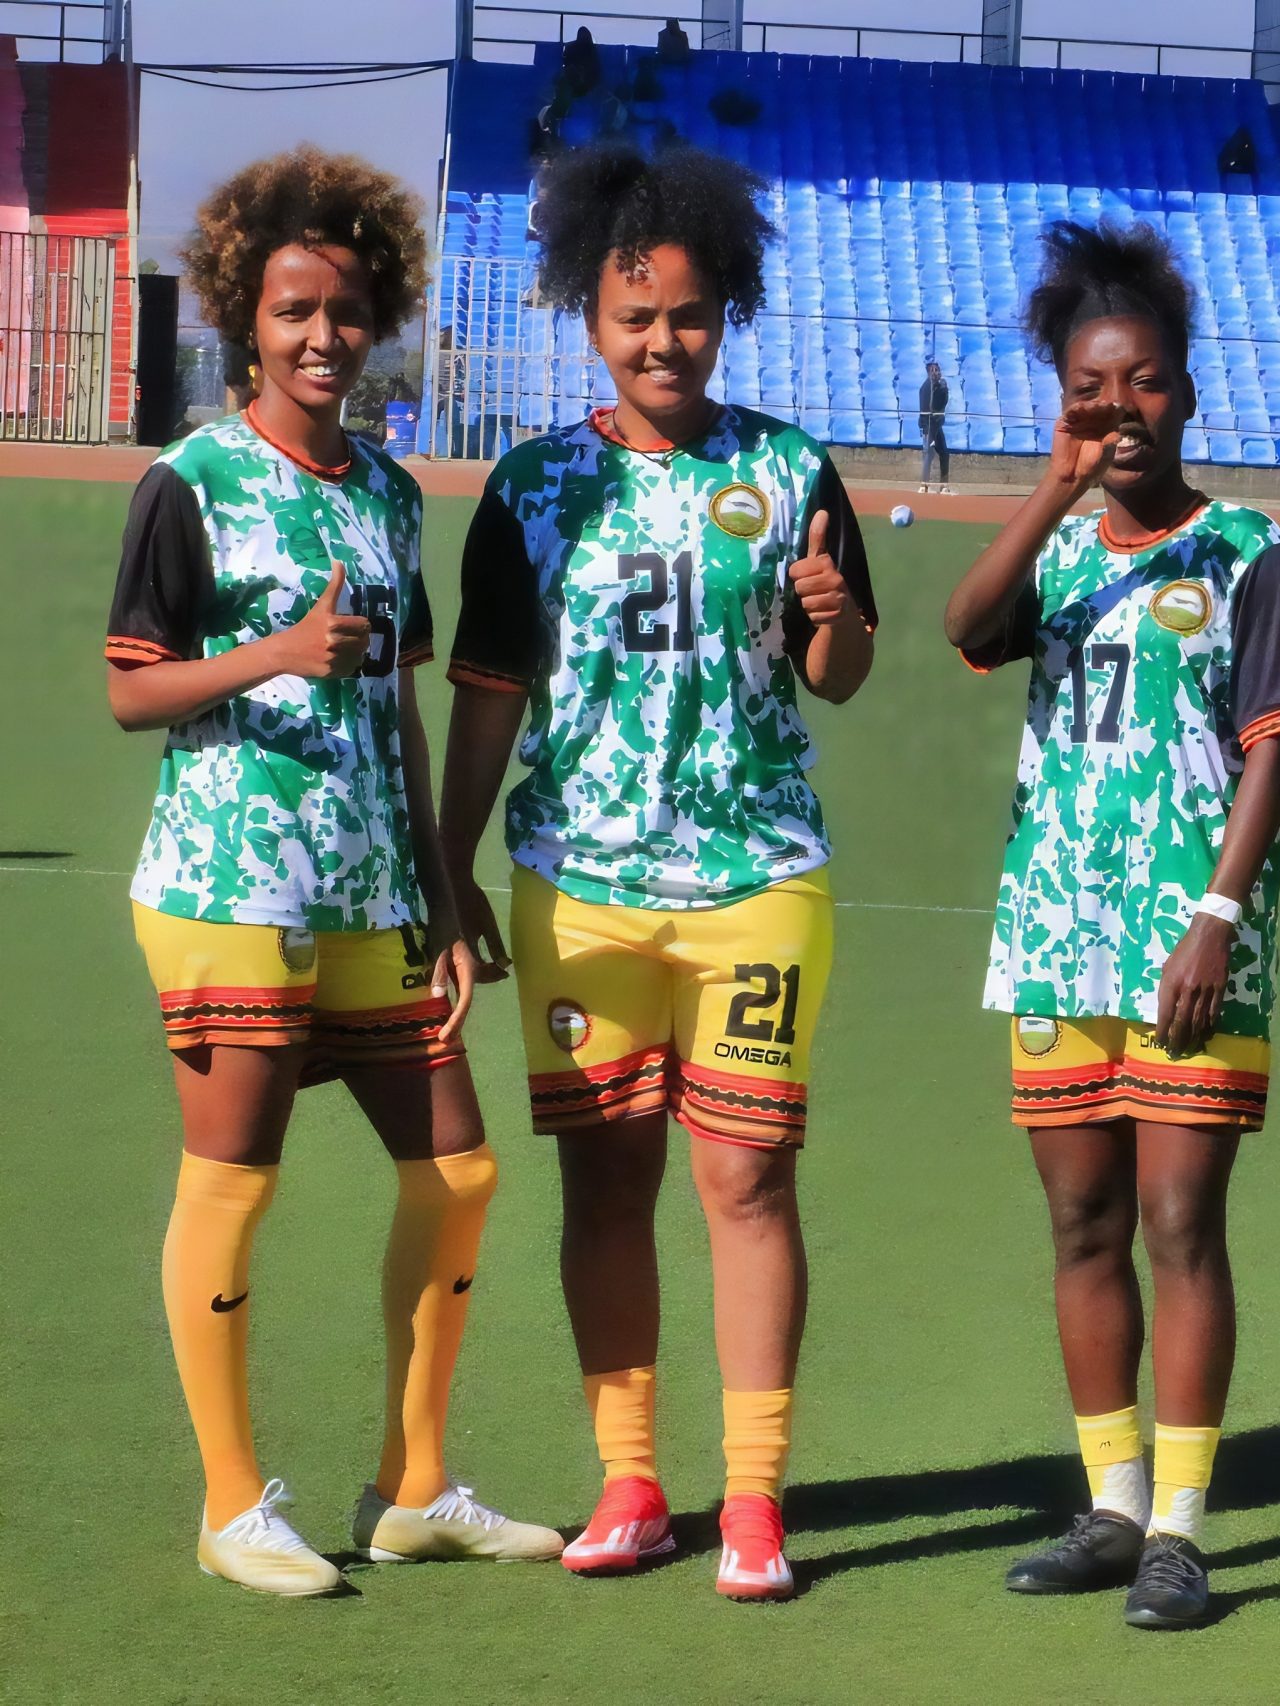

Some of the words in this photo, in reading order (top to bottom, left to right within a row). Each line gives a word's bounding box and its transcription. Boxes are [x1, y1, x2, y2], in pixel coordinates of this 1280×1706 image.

[617, 550, 695, 652] 21
[1067, 643, 1131, 743] 17
[725, 963, 800, 1046] 21
[714, 1042, 792, 1068] OMEGA
